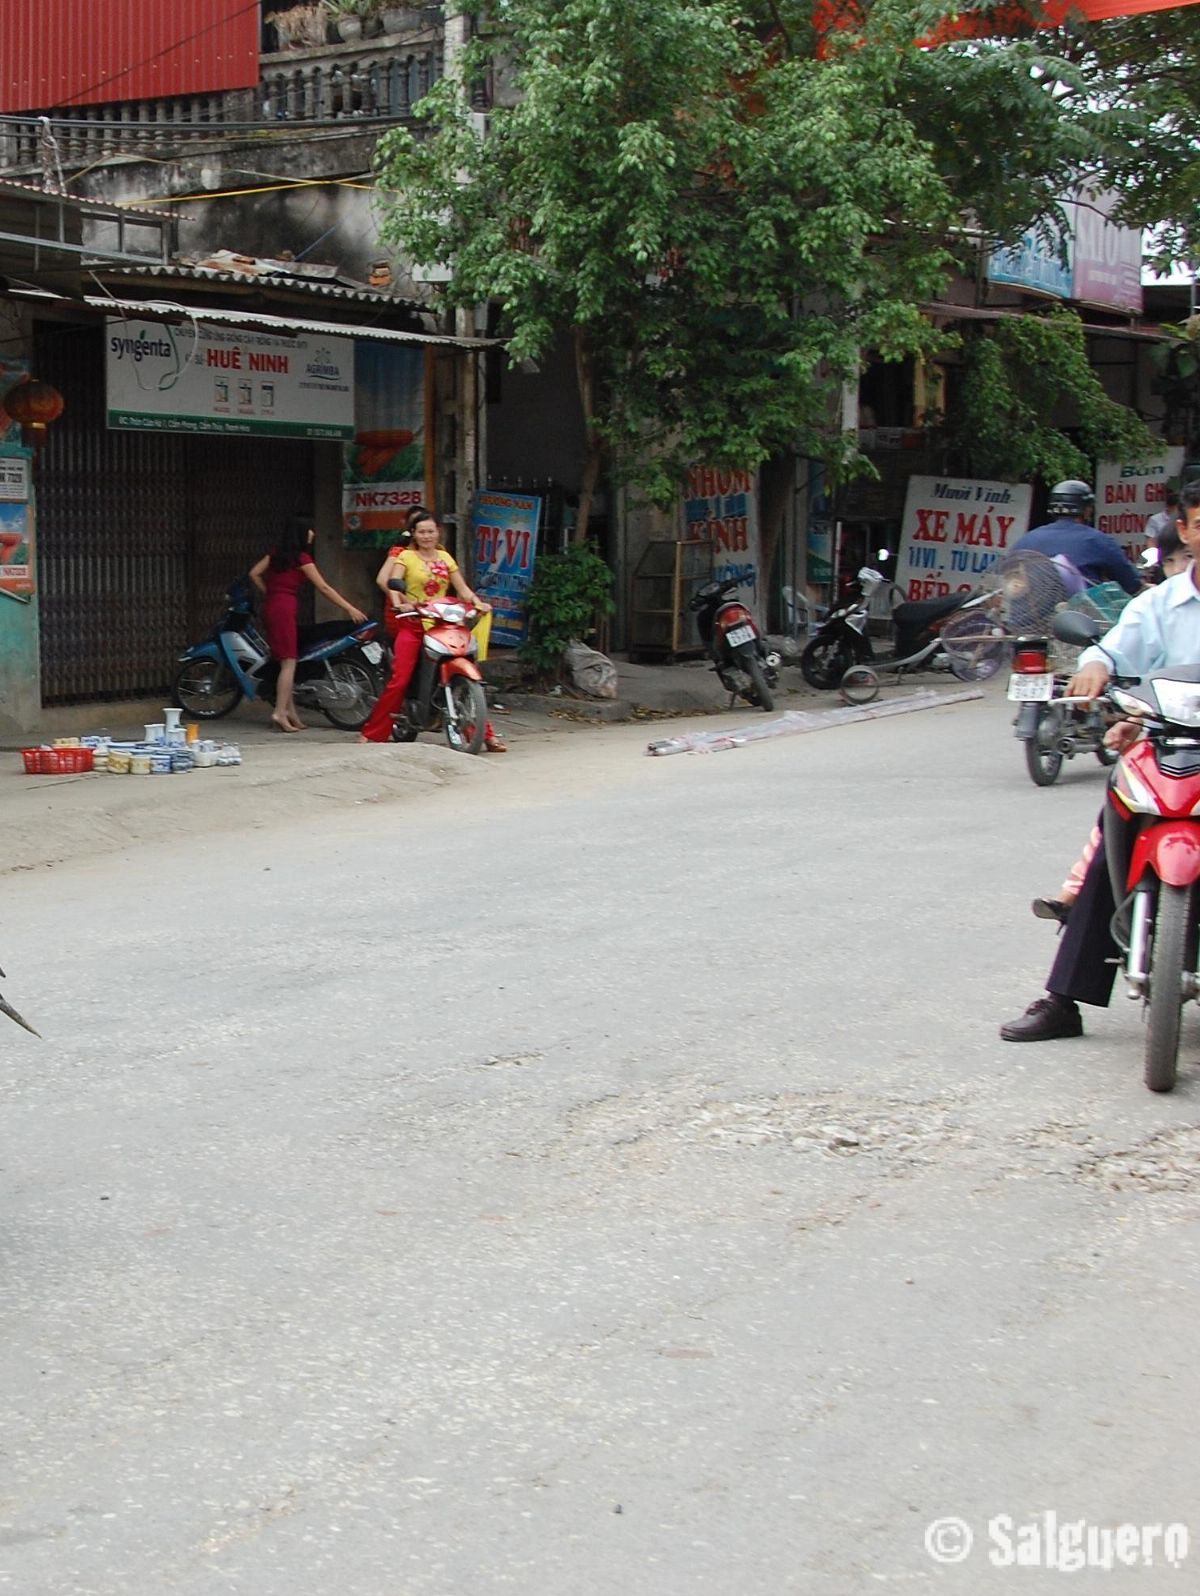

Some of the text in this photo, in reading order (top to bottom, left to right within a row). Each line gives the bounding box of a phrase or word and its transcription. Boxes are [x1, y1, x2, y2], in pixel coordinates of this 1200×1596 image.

[111, 335, 171, 362] syngenta
[207, 346, 241, 370] HUÊ
[249, 353, 289, 374] NINH
[1144, 482, 1168, 503] GH
[912, 505, 1015, 549] XE MÁY
